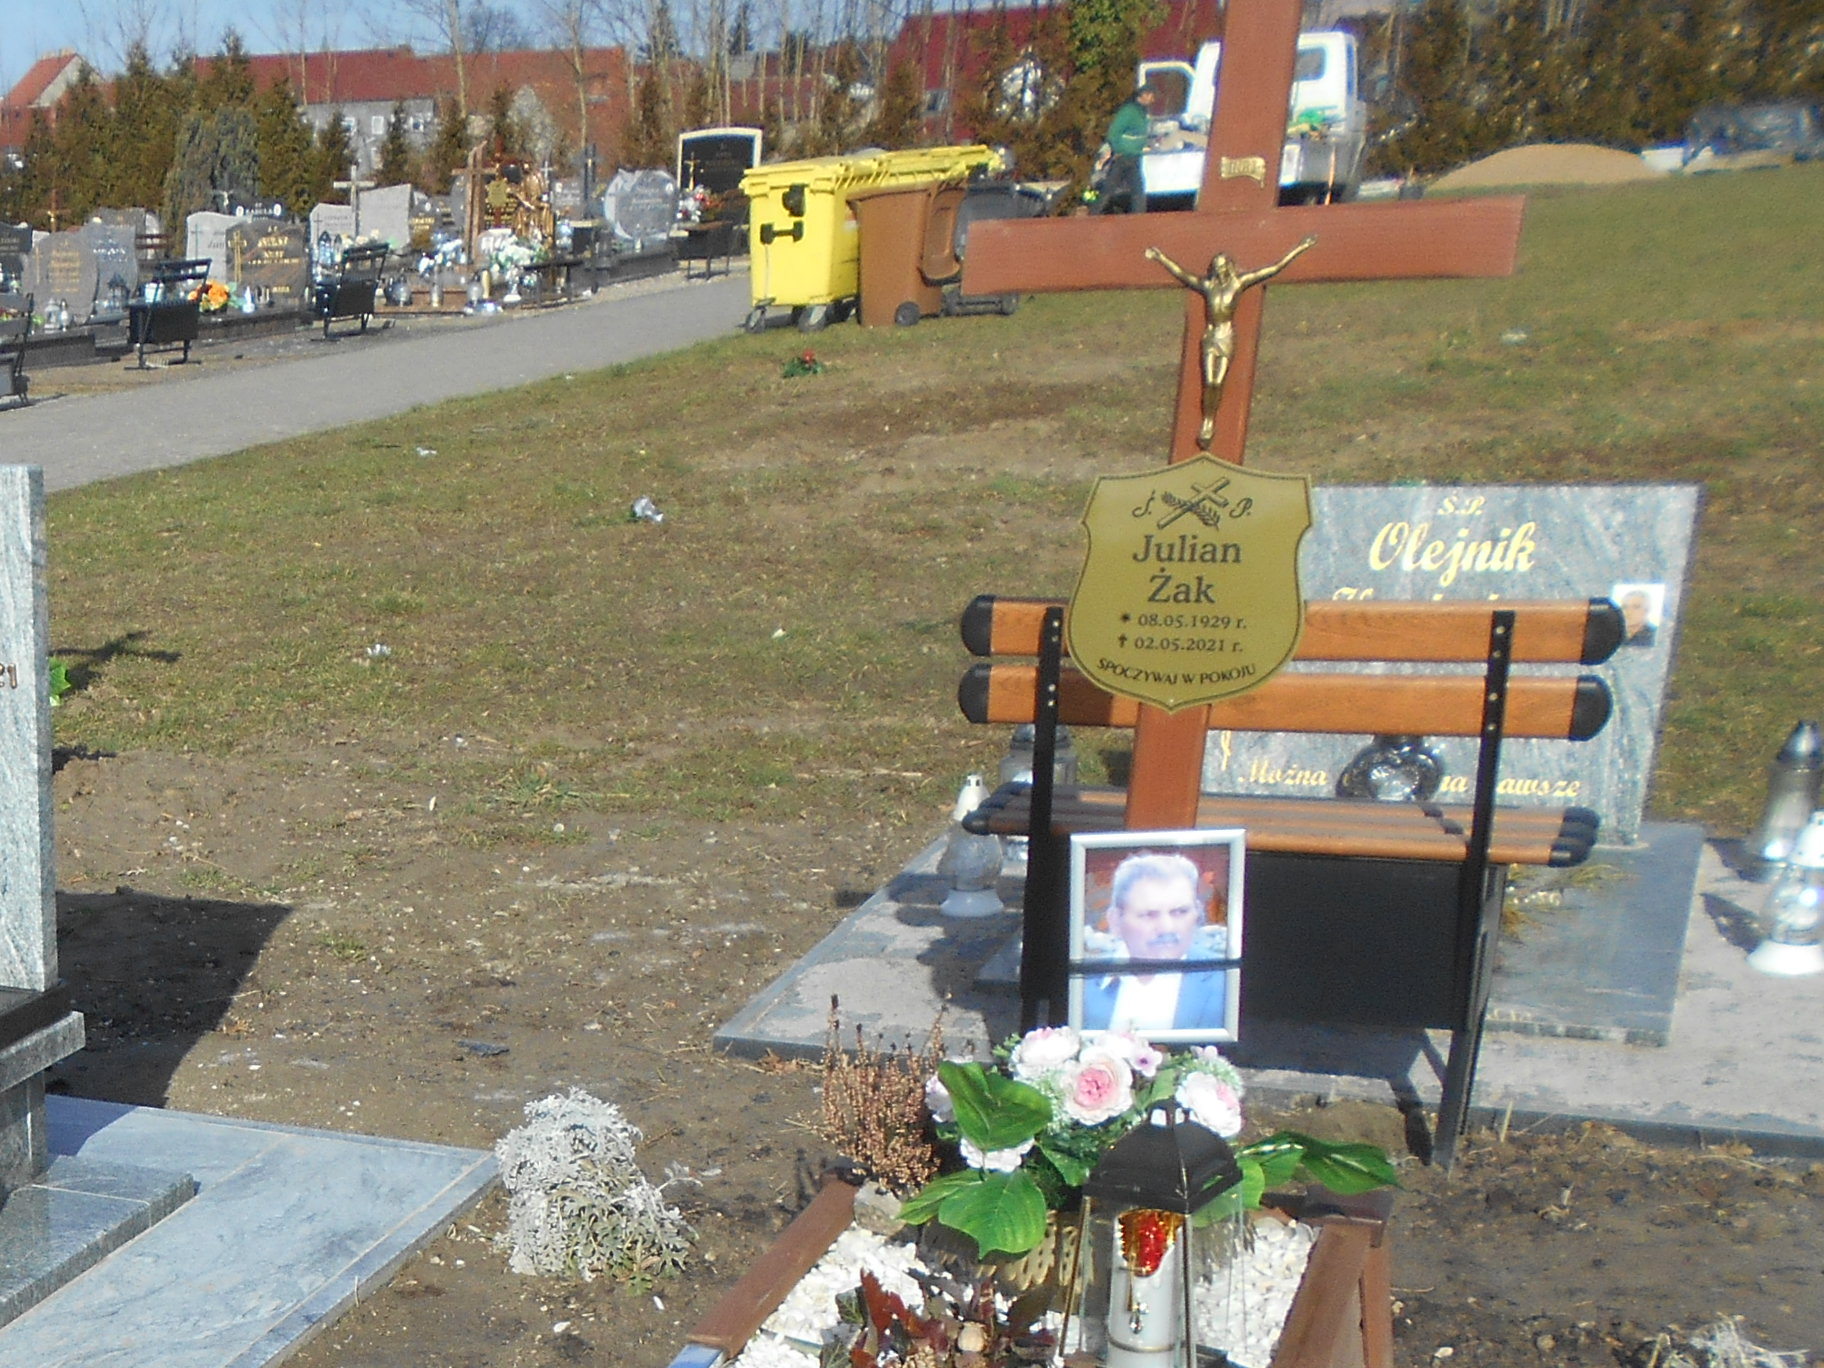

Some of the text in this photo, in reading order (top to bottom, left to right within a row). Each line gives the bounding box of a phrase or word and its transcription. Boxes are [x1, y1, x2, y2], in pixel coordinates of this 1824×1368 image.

[1133, 534, 1242, 564] Julian
[1369, 521, 1536, 586] Olejnik
[1148, 567, 1216, 604] Żak
[1138, 615, 1247, 629] 08.05.1929 r.
[1134, 638, 1243, 652] 02.05.2021 r.
[1097, 658, 1256, 685] SPOCZYWAJ W POKOJU
[1238, 759, 1328, 787] Można
[1496, 778, 1582, 797] awsze
